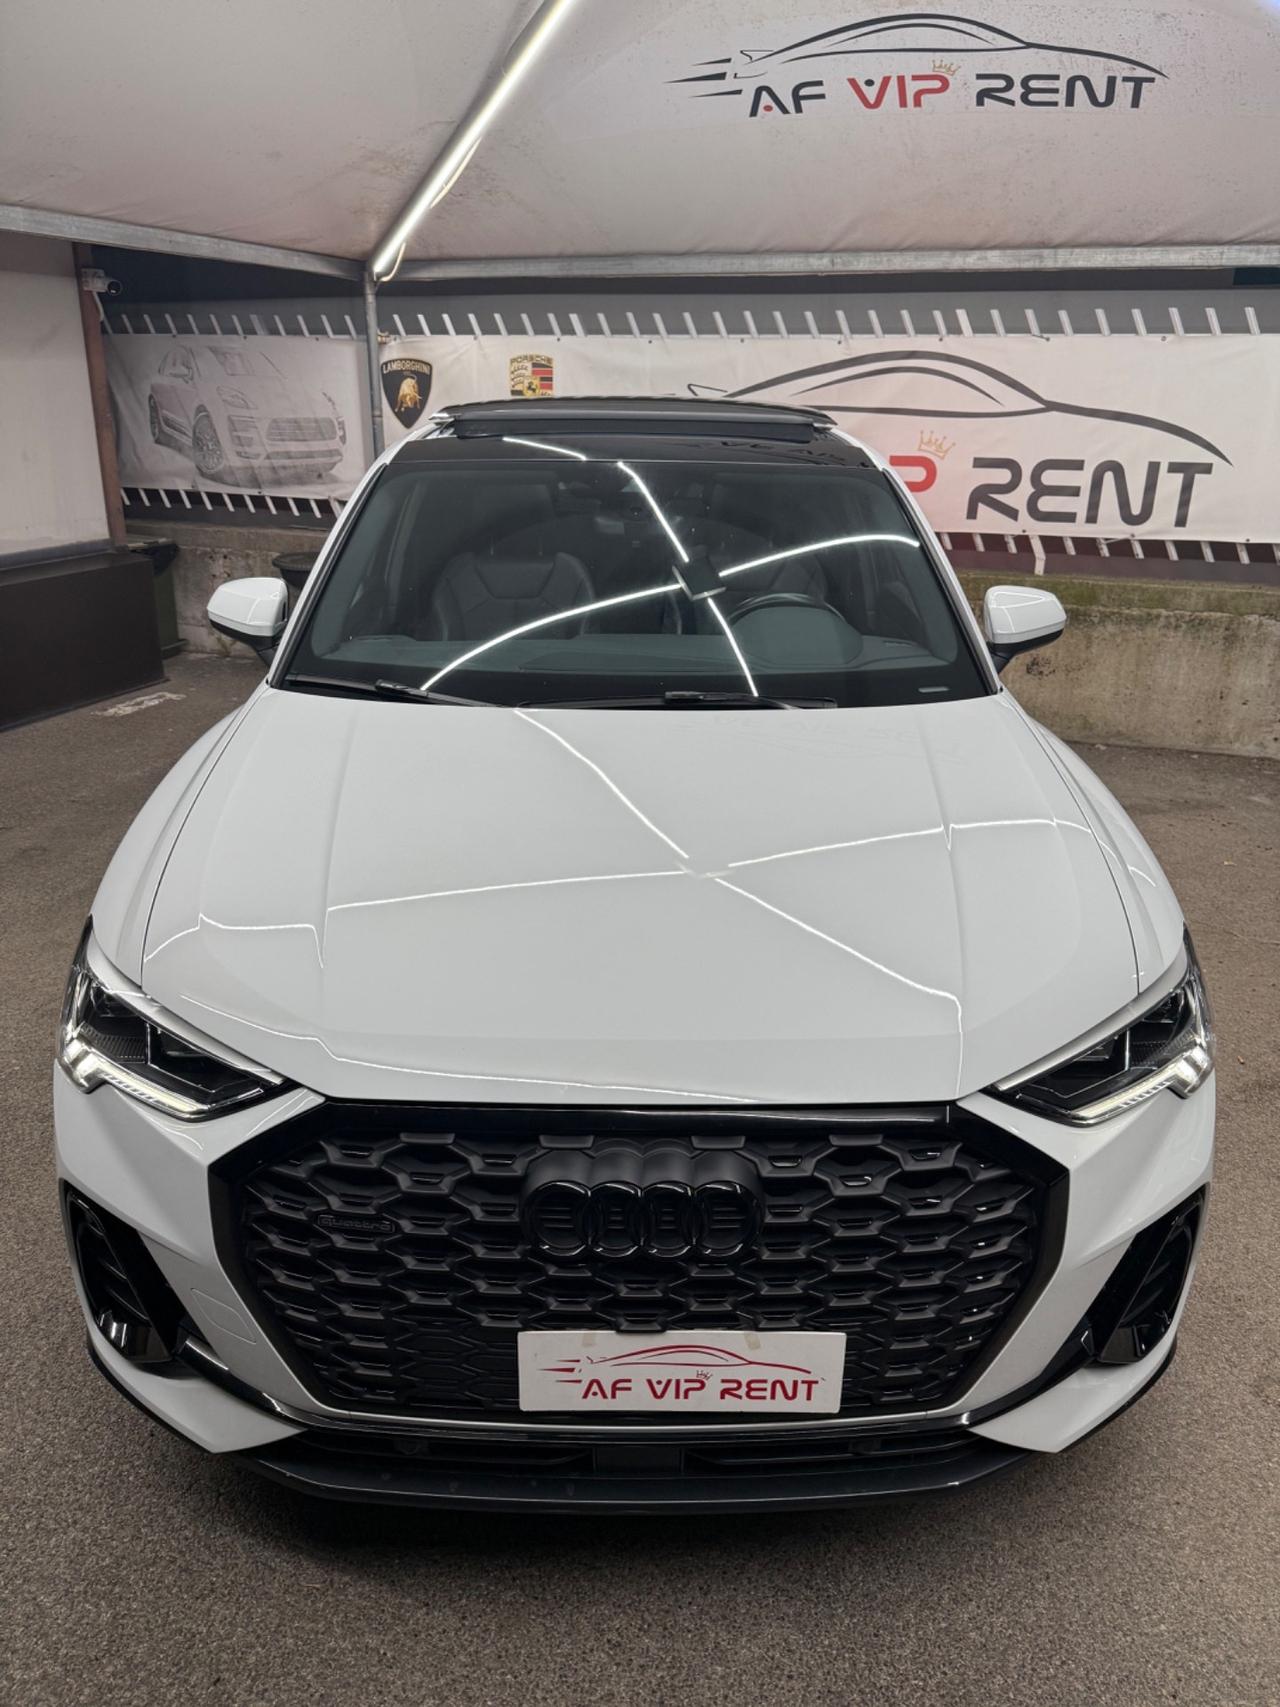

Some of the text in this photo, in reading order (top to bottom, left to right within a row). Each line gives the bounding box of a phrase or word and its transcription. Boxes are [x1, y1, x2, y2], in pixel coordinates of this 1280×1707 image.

[749, 73, 1156, 117] AF VIP RENT
[382, 359, 431, 375] LAMBORGHINI
[966, 456, 1213, 528] RENT
[581, 1378, 820, 1401] AF VIP RENT
